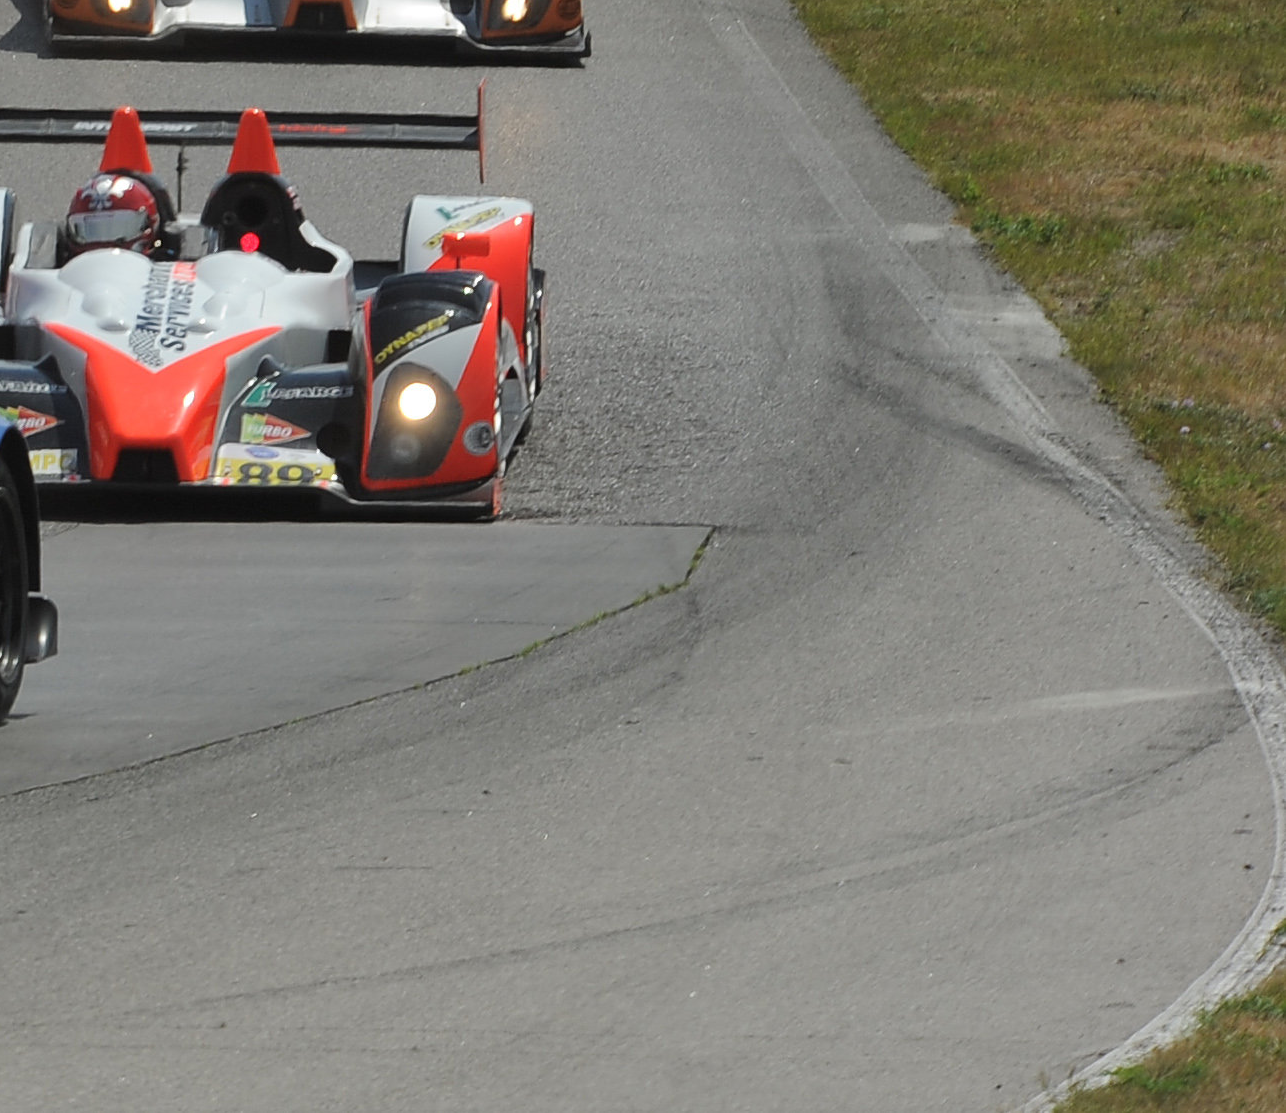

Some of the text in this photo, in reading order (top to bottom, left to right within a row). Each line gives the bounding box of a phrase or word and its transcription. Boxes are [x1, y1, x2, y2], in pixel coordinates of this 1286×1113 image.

[160, 280, 196, 352] Services
[247, 424, 293, 437] TURBO
[238, 462, 316, 486] 89
